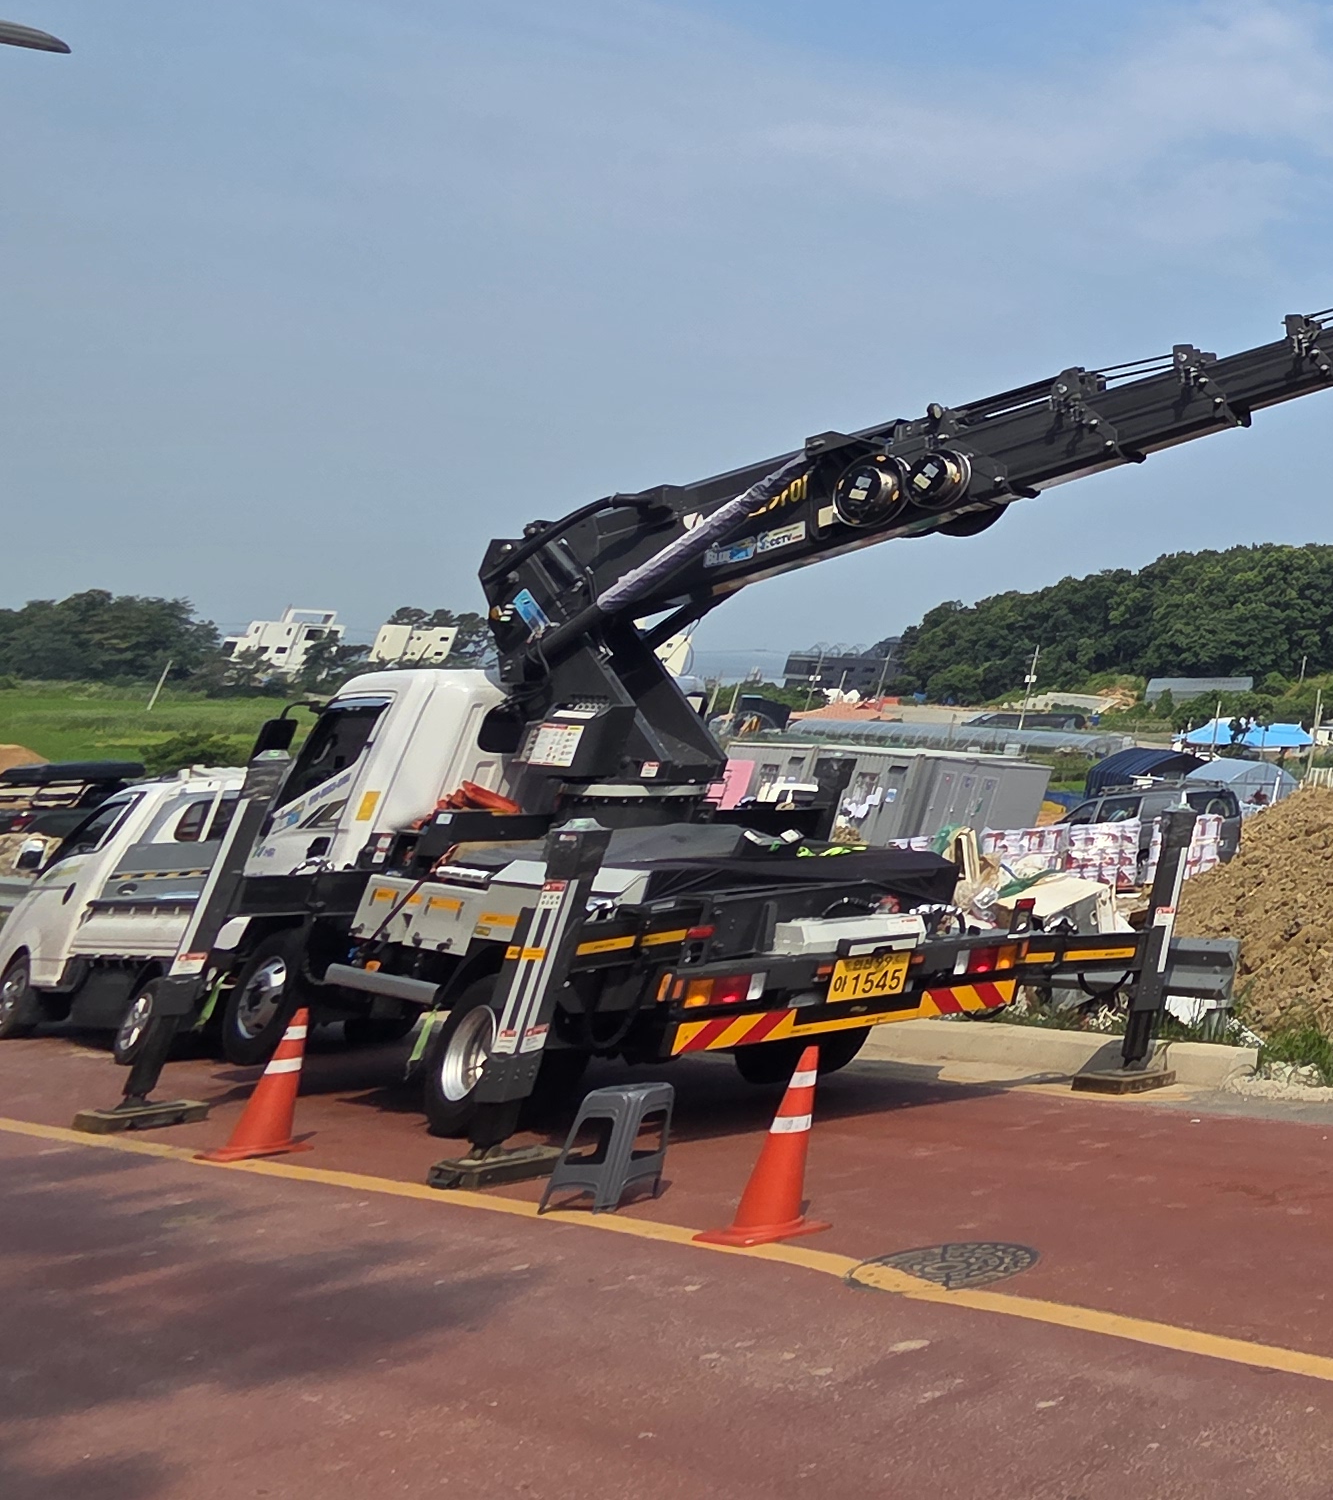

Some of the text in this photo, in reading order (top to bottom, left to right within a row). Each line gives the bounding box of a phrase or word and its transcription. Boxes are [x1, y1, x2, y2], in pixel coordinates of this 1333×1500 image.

[770, 533, 792, 547] CCTV
[833, 968, 903, 995] 아 1545
